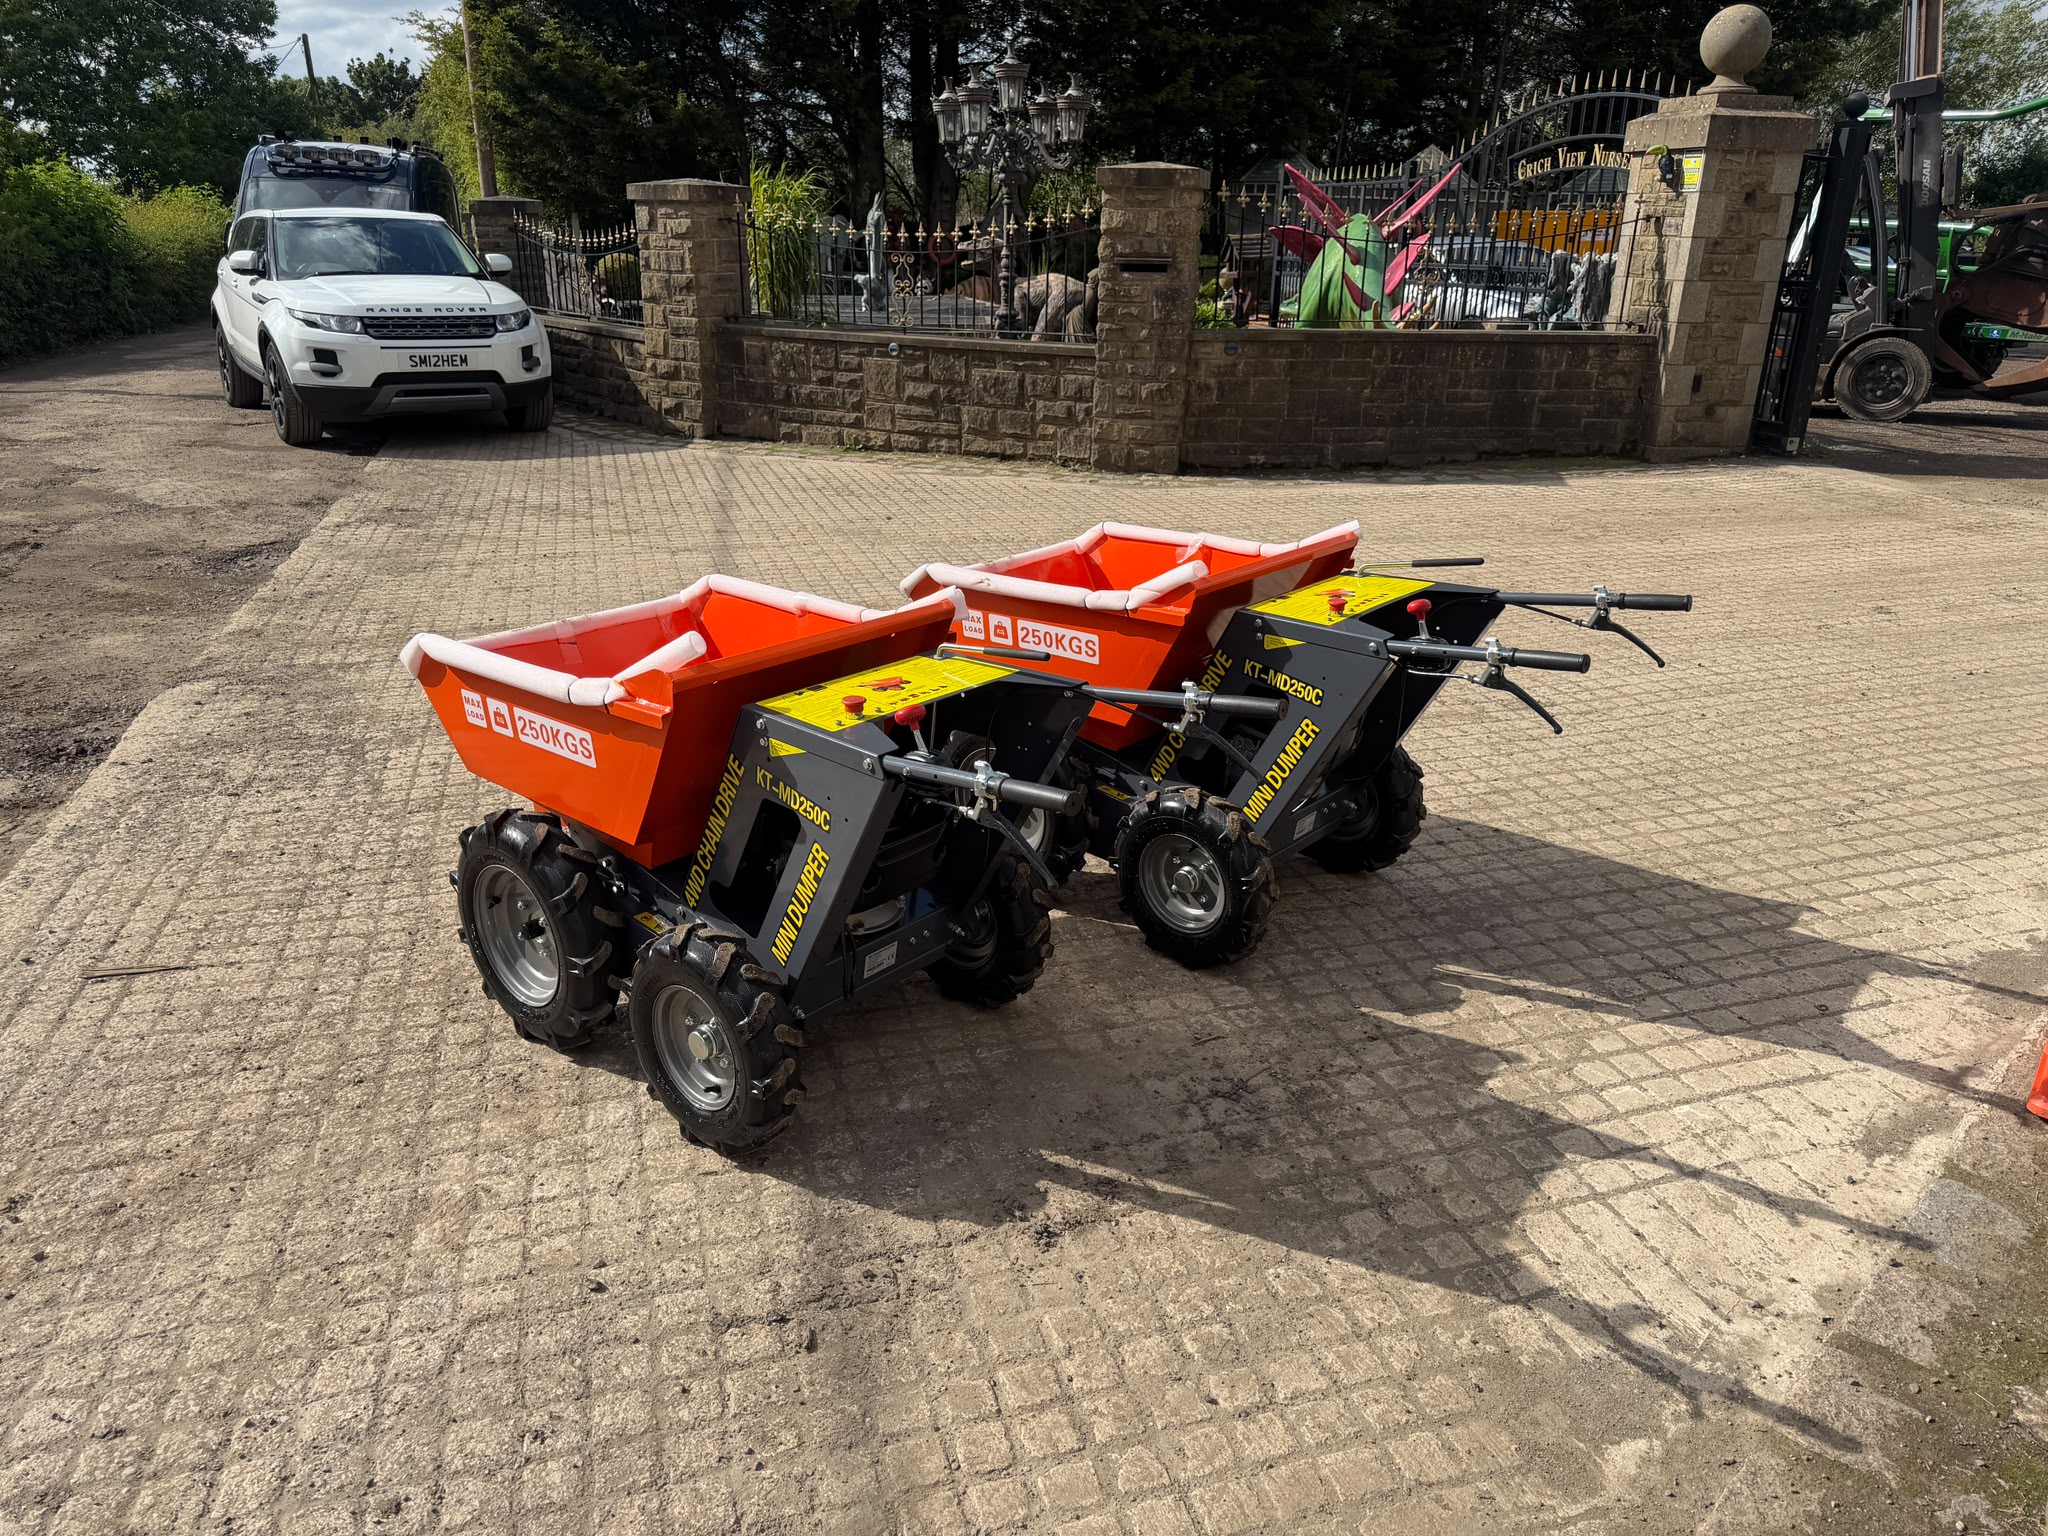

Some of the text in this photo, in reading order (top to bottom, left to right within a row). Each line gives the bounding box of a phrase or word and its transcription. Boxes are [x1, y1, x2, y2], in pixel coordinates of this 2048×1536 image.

[1518, 143, 1632, 180] CRICH VIEW NURSE
[1921, 159, 1932, 206] DOOSAN
[964, 625, 983, 634] LOAD
[966, 614, 982, 624] AX
[1020, 626, 1097, 658] 250KGS
[463, 695, 482, 709] MAX
[1243, 658, 1323, 706] KT-MD250C
[466, 709, 485, 721] LOAD
[517, 715, 593, 760] 250KGS
[1265, 718, 1321, 790] DUMPER
[1150, 745, 1178, 783] 4WD
[755, 765, 831, 832] KT-MD250C
[684, 753, 745, 908] 4WD CHAIN DRIVE
[771, 842, 831, 966] MINI DUMPER
